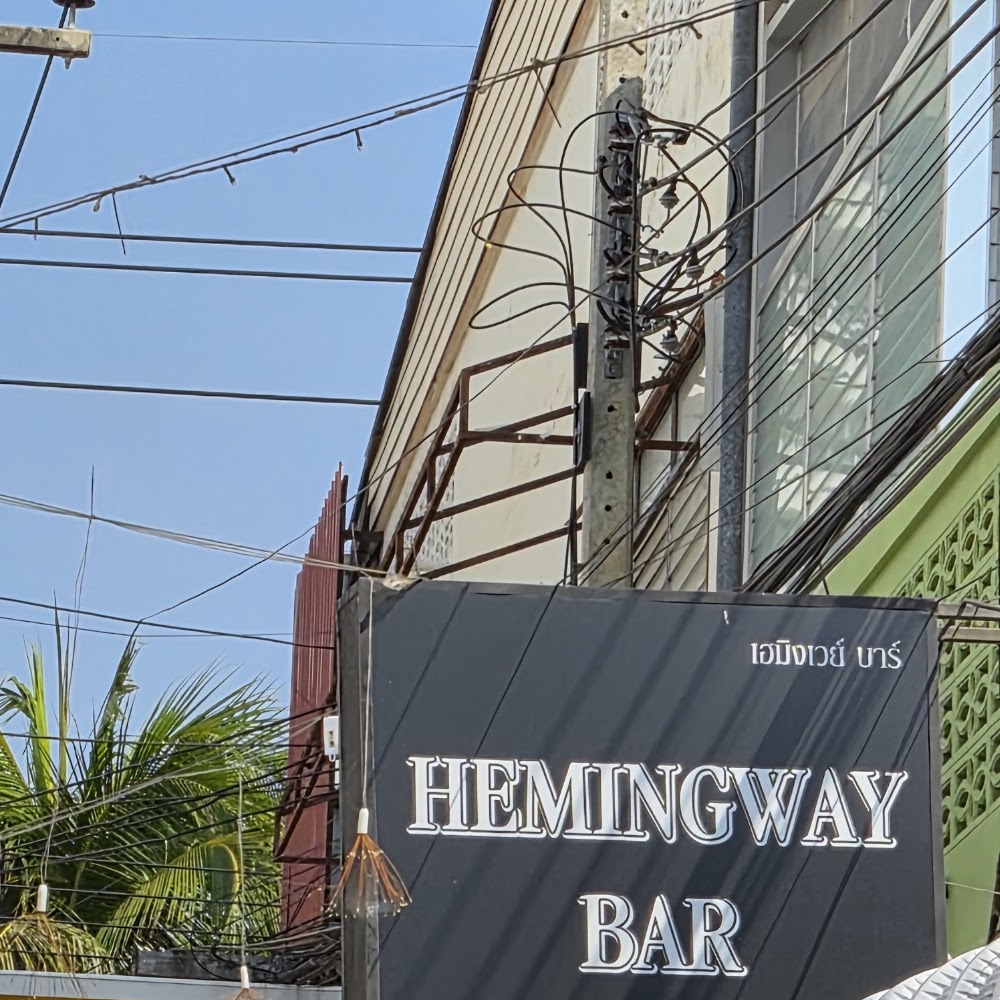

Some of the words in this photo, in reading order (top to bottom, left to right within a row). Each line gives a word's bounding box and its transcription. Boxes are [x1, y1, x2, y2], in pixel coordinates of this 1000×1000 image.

[750, 638, 845, 667] เฮมิงเวย์
[857, 641, 902, 669] บาร์
[405, 755, 908, 848] HEMINGWAY
[577, 894, 748, 977] BAR
